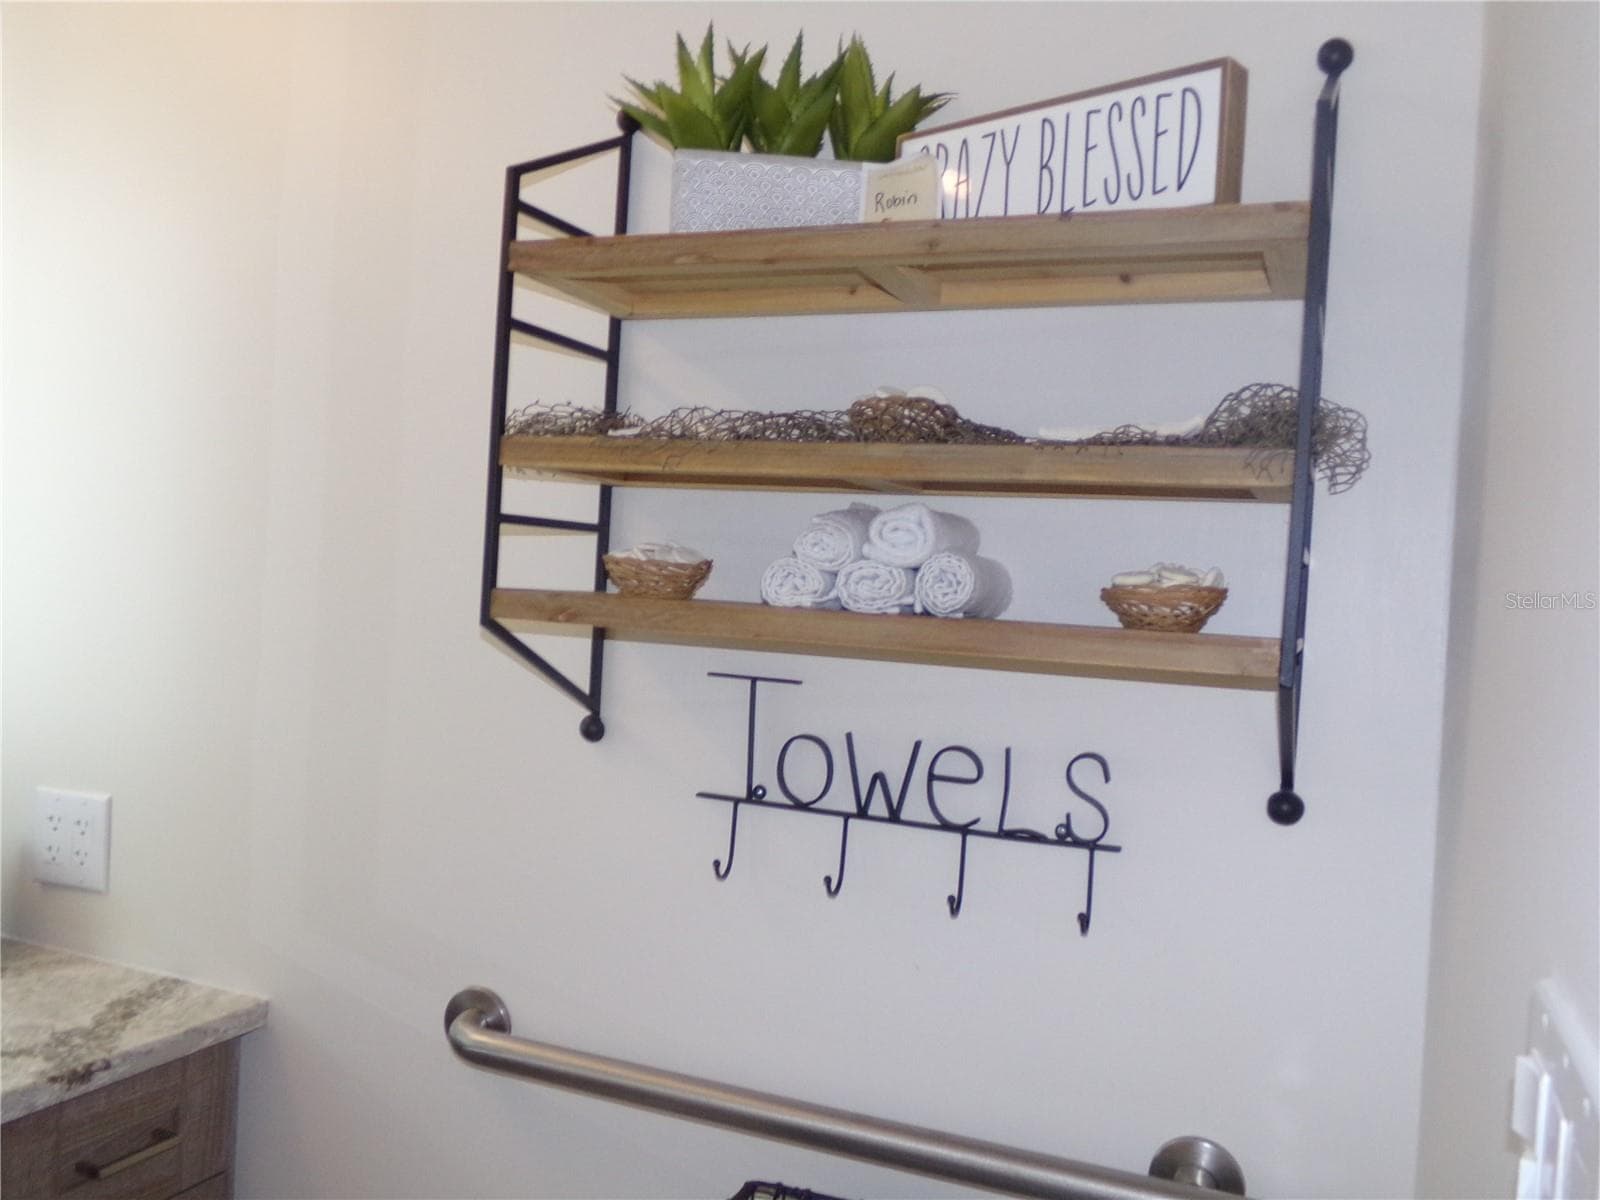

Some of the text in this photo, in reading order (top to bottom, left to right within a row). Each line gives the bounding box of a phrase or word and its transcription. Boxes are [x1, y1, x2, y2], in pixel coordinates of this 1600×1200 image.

[920, 87, 1201, 220] RAZY BLESSED
[874, 191, 918, 213] Robin
